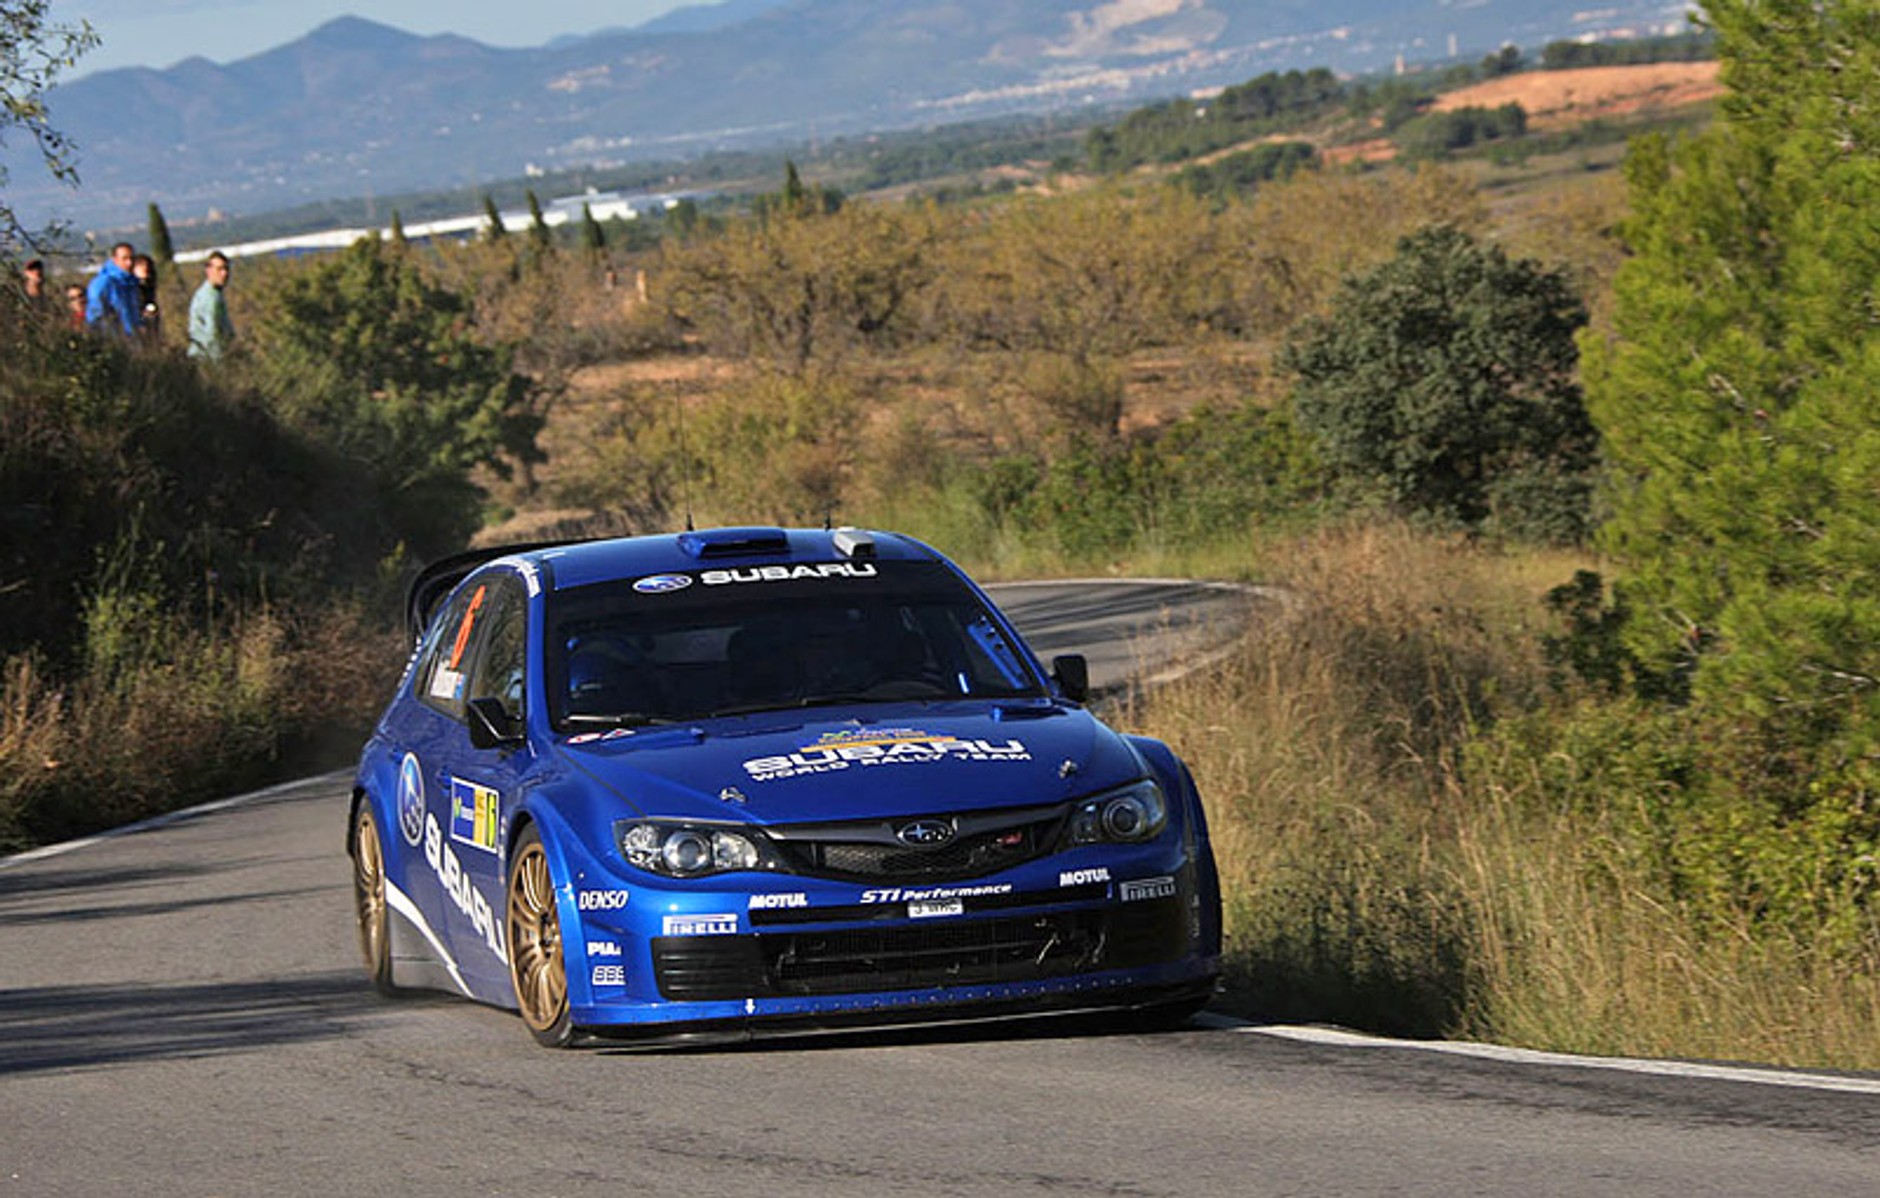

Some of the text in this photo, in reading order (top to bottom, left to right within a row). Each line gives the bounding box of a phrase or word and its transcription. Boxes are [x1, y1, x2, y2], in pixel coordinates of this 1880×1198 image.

[700, 562, 878, 584] SUBARU
[743, 739, 1026, 775] SUBARU
[752, 751, 1033, 781] WORLD RALLY TEAM
[1059, 867, 1111, 888] MOTUL
[1120, 876, 1175, 901] PIRELLI
[425, 812, 510, 966] SUBARU
[860, 883, 1012, 903] STI Performance
[578, 890, 629, 911] DENSO
[749, 893, 807, 908] MOTUL
[662, 913, 738, 935] PIRELLI
